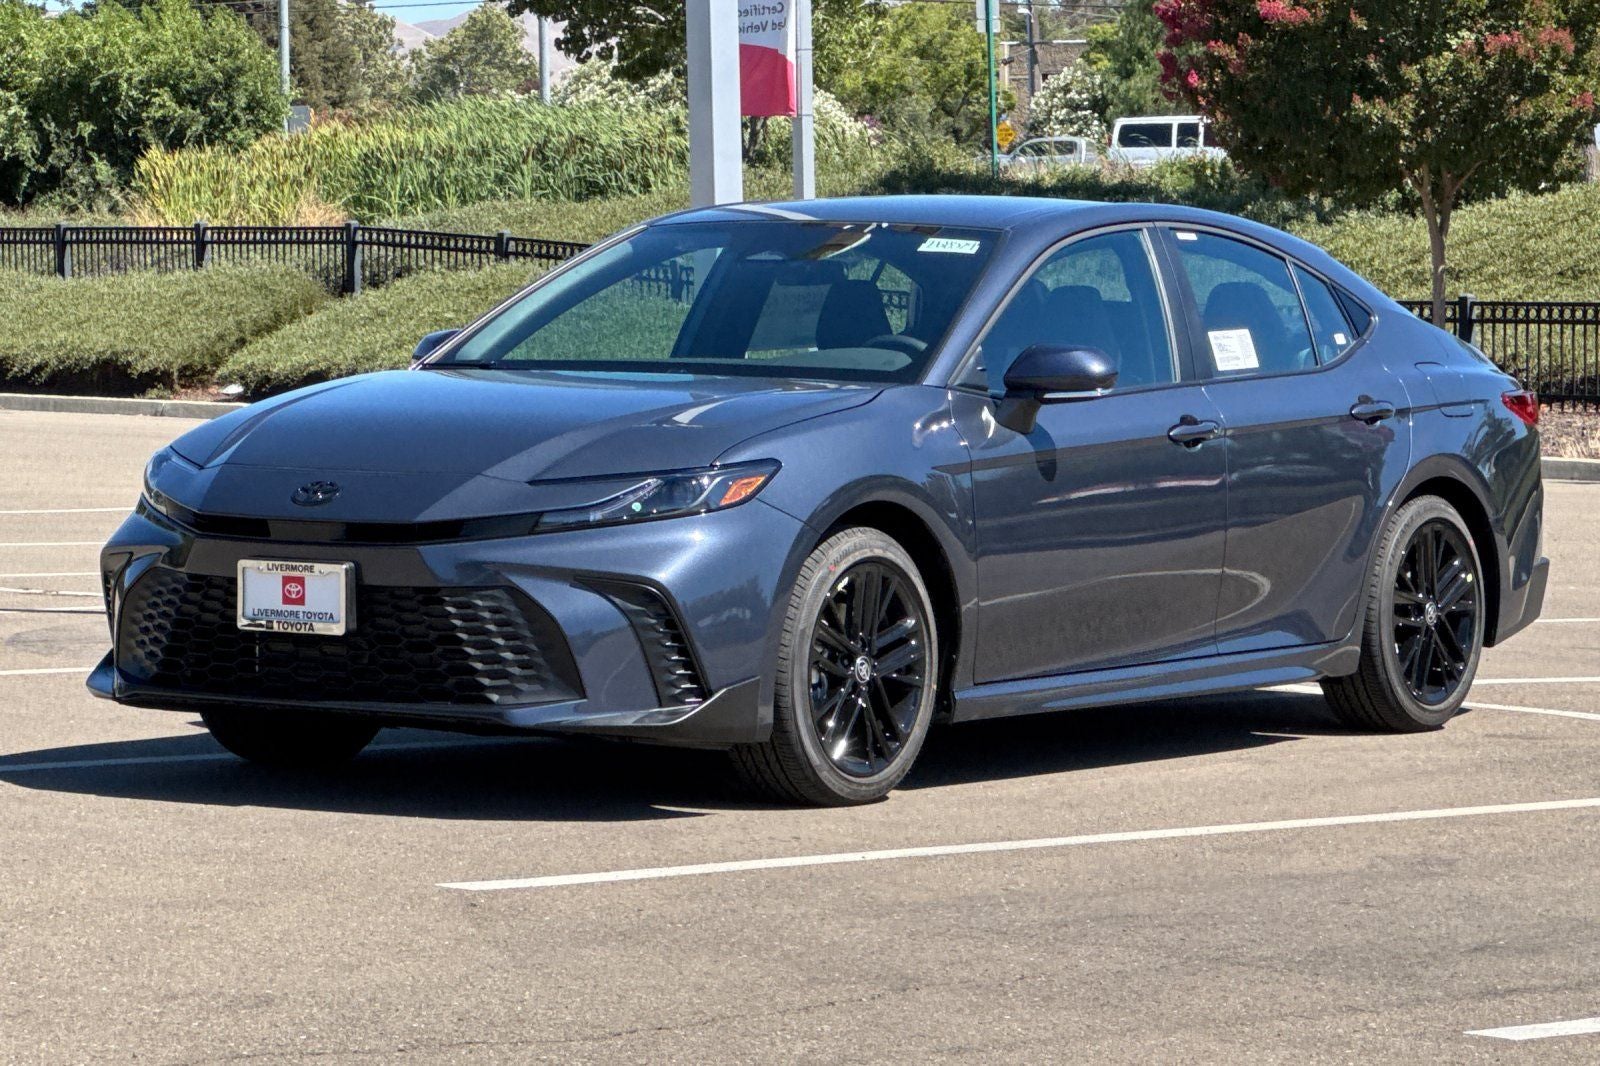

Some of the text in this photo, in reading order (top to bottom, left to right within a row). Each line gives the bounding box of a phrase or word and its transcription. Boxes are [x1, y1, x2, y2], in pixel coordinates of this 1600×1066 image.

[266, 563, 315, 573] LIVERMORE
[252, 608, 334, 621] LIVERMORE TOYOTA
[275, 620, 315, 632] TOYOTA
